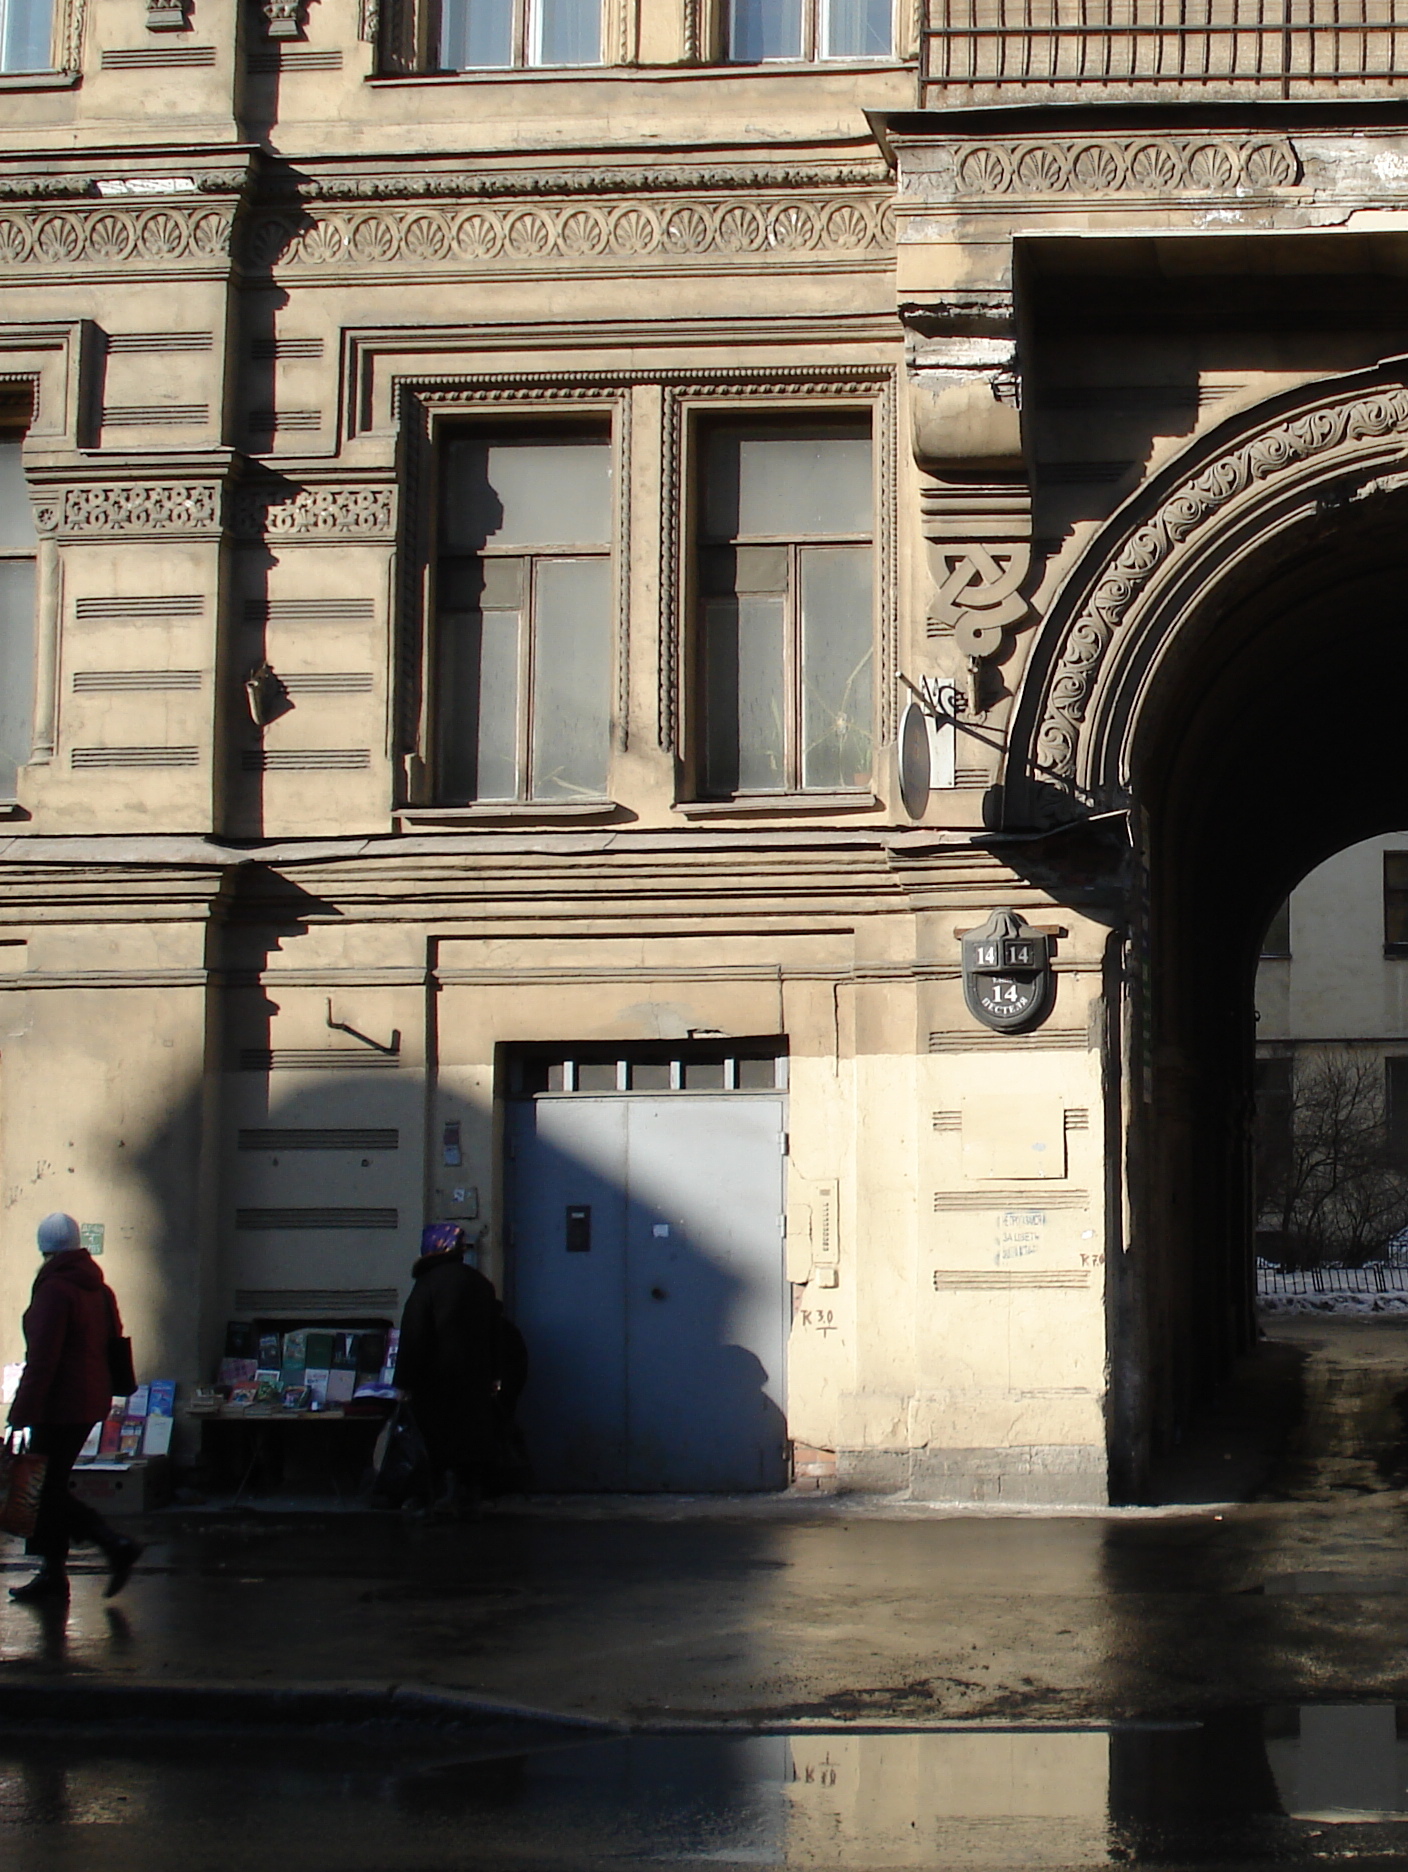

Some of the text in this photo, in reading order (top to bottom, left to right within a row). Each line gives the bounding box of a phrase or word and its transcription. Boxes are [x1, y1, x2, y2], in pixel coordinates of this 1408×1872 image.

[977, 946, 995, 965] 14
[1010, 946, 1029, 964] 14
[992, 984, 1018, 1003] 14
[981, 996, 1028, 1015] ПЕСТЕЛЯ
